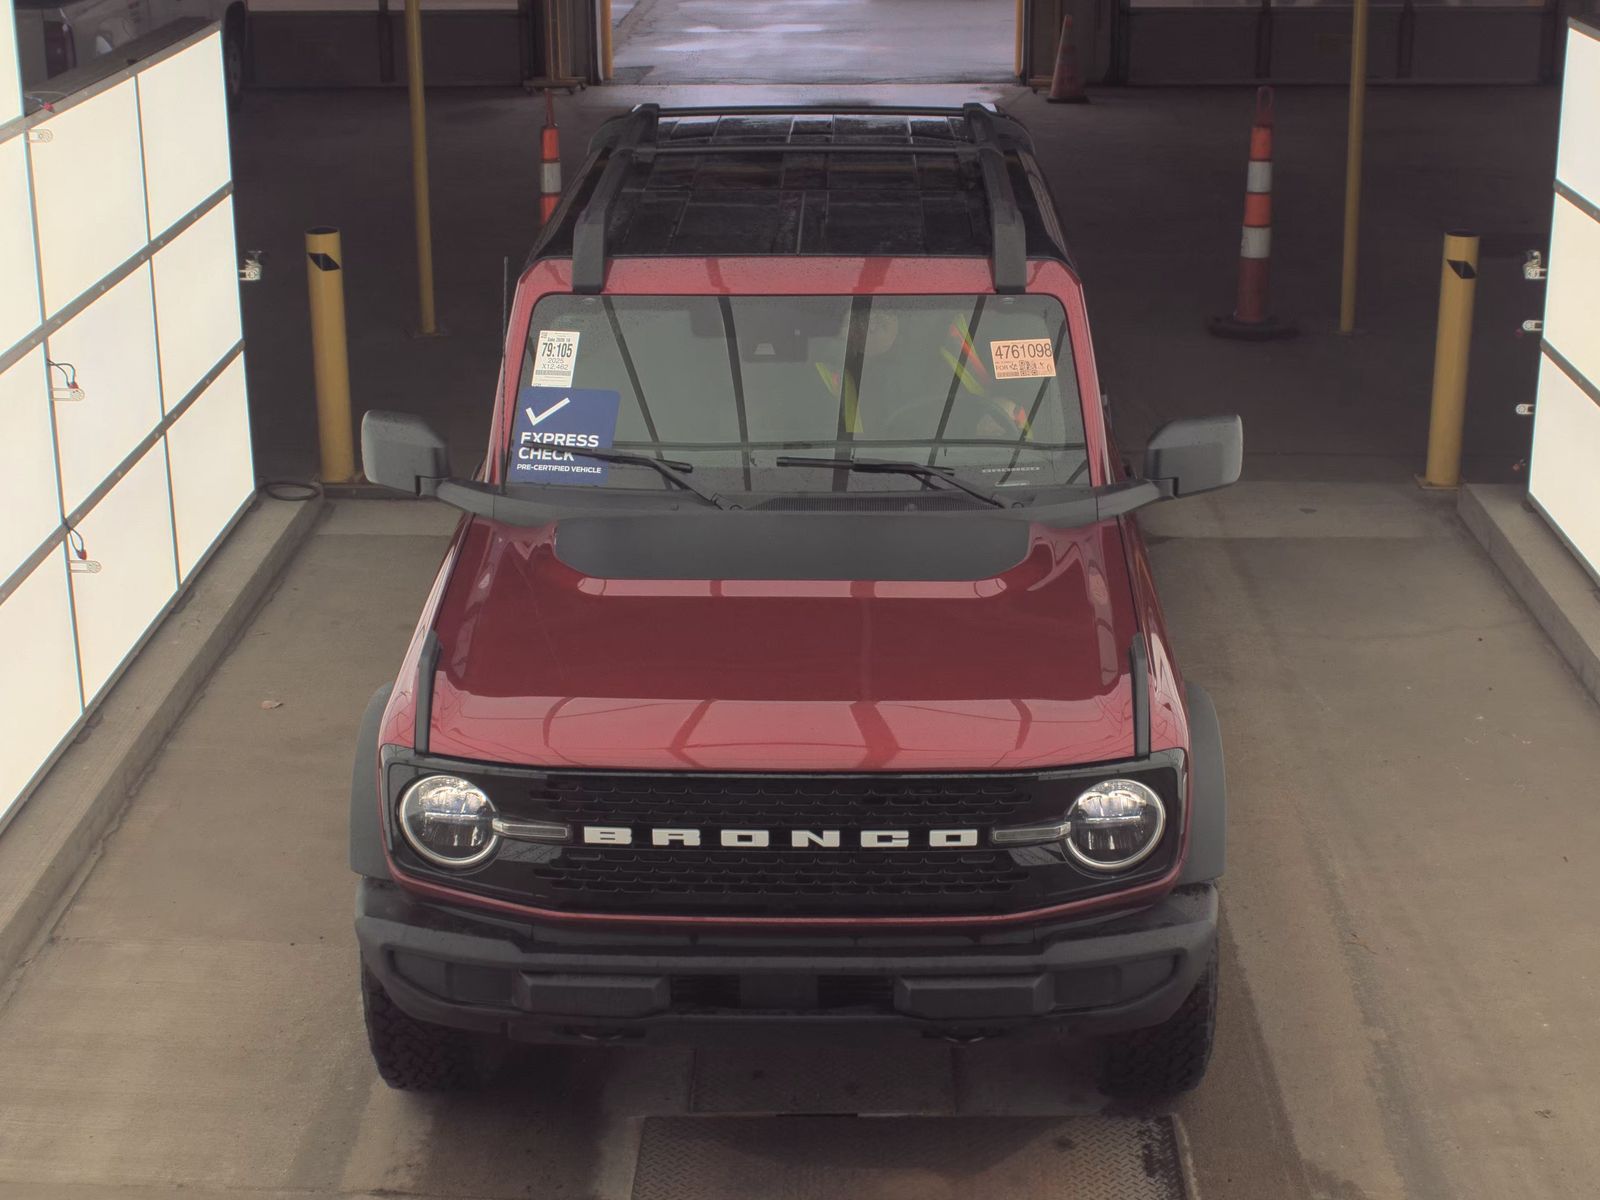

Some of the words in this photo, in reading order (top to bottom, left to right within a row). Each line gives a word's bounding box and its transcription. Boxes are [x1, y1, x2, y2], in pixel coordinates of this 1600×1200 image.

[541, 342, 573, 358] 79:105
[995, 343, 1052, 359] 4761098
[520, 432, 599, 447] EXPRESS
[518, 447, 574, 461] CHECK
[516, 463, 570, 472] PRE-CERTIFIED
[571, 466, 602, 474] VEHICLE
[583, 826, 980, 848] BRONCO
